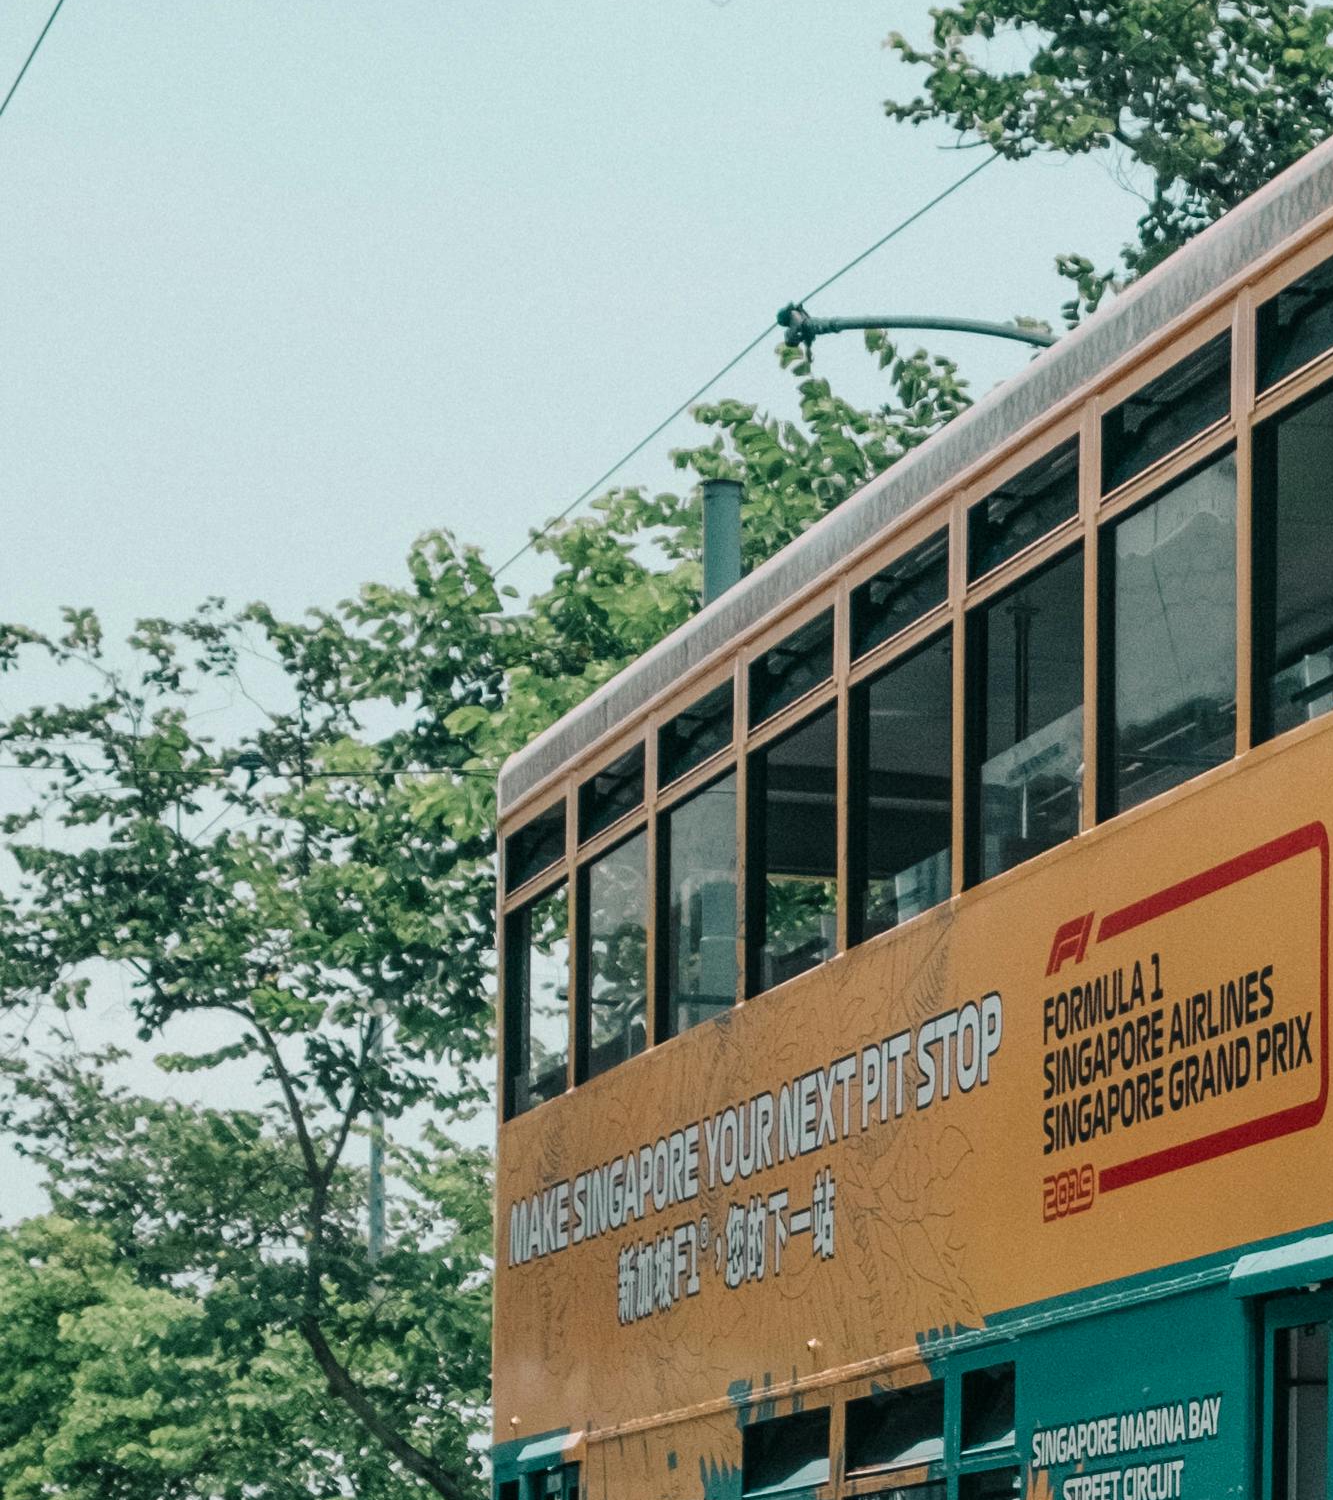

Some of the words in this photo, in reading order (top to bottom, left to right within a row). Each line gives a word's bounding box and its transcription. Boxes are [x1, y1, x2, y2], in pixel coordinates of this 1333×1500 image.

[1043, 960, 1145, 1045] FORMULA
[1151, 952, 1164, 1002] 1
[1043, 1008, 1164, 1100] SINGAPORE
[1168, 964, 1274, 1053] AIRLINES
[508, 1179, 570, 1269] MAKE
[572, 1121, 700, 1245] SINGAPORE
[703, 1091, 774, 1188] YOUR
[778, 1052, 857, 1164] NEXT
[861, 1028, 912, 1132] PIT
[916, 990, 1003, 1111] STOP
[1043, 1067, 1164, 1156] SINGAPORE
[1168, 1035, 1251, 1112] GRAND
[1256, 1011, 1313, 1082] PRIX
[1043, 1163, 1095, 1224] 2019
[1032, 1416, 1118, 1468] SINGAPORE
[1120, 1403, 1187, 1452] MARINA
[1189, 1396, 1222, 1440] BAY
